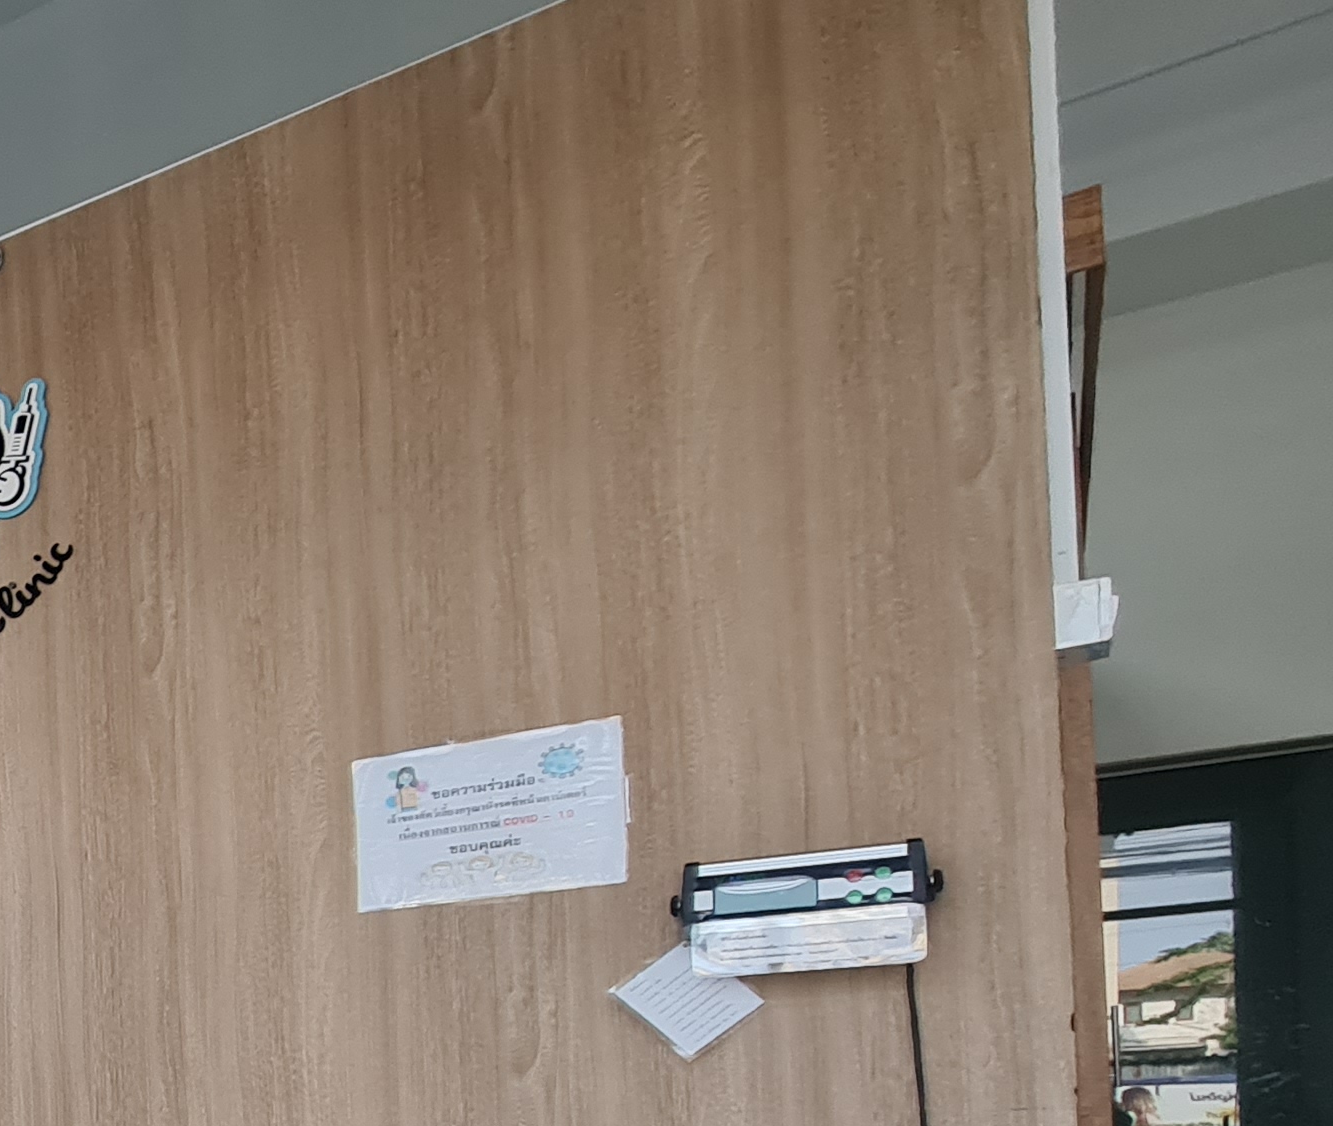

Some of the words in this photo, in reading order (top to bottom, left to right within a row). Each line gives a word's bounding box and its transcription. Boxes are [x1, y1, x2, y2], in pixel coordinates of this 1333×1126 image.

[431, 773, 536, 800] ขอความร่วมมือ
[503, 814, 538, 827] COVID
[449, 836, 522, 855] ขอบคุณค่ะ
